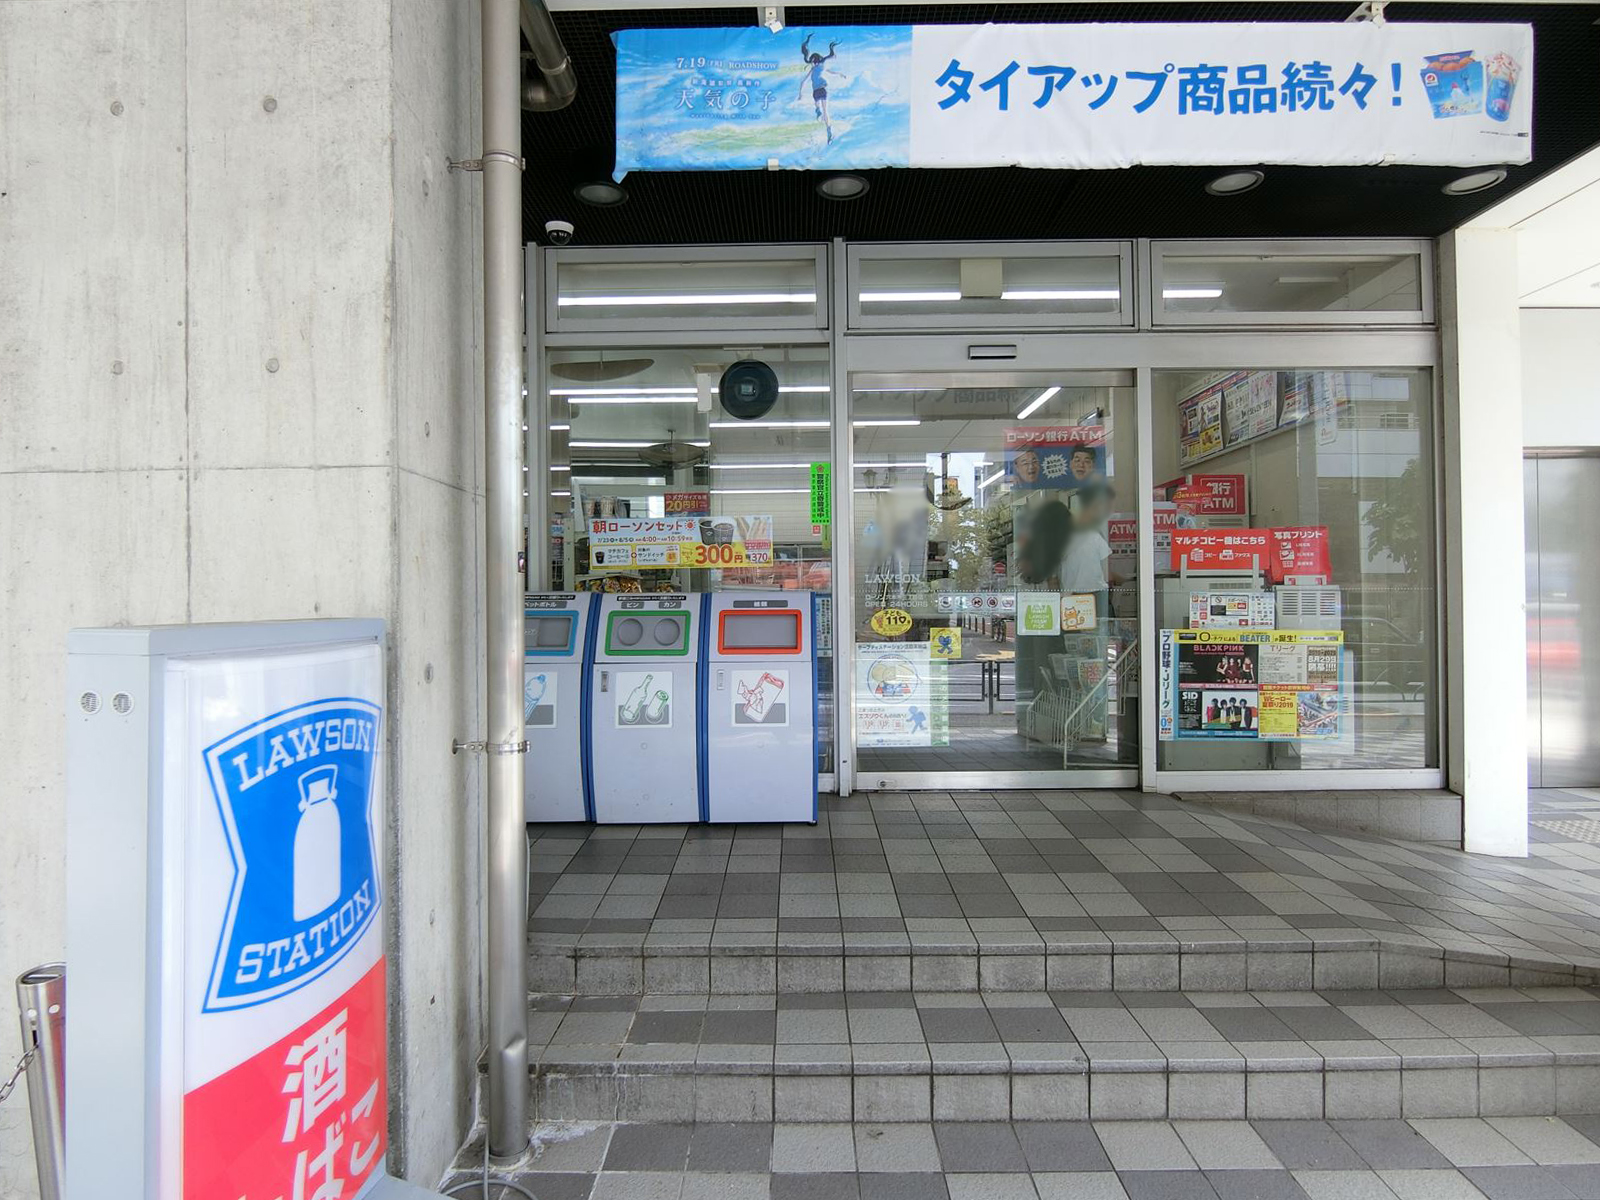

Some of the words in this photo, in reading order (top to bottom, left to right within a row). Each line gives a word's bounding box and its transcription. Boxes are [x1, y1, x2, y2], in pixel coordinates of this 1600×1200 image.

[677, 57, 706, 69] 7.19
[728, 61, 779, 69] ROADSHOW
[934, 58, 1402, 116] タイアップ商品続々!
[676, 88, 777, 112] 天気の子
[1203, 497, 1234, 509] ATM
[1153, 513, 1176, 525] TM
[592, 520, 683, 534] 朝ローソンセット
[1109, 524, 1137, 535] ATM
[1239, 635, 1271, 643] BEATER
[1181, 691, 1199, 700] SID
[232, 718, 373, 793] LAWSON
[235, 879, 372, 985] STATION
[281, 1007, 348, 1143] 酒
